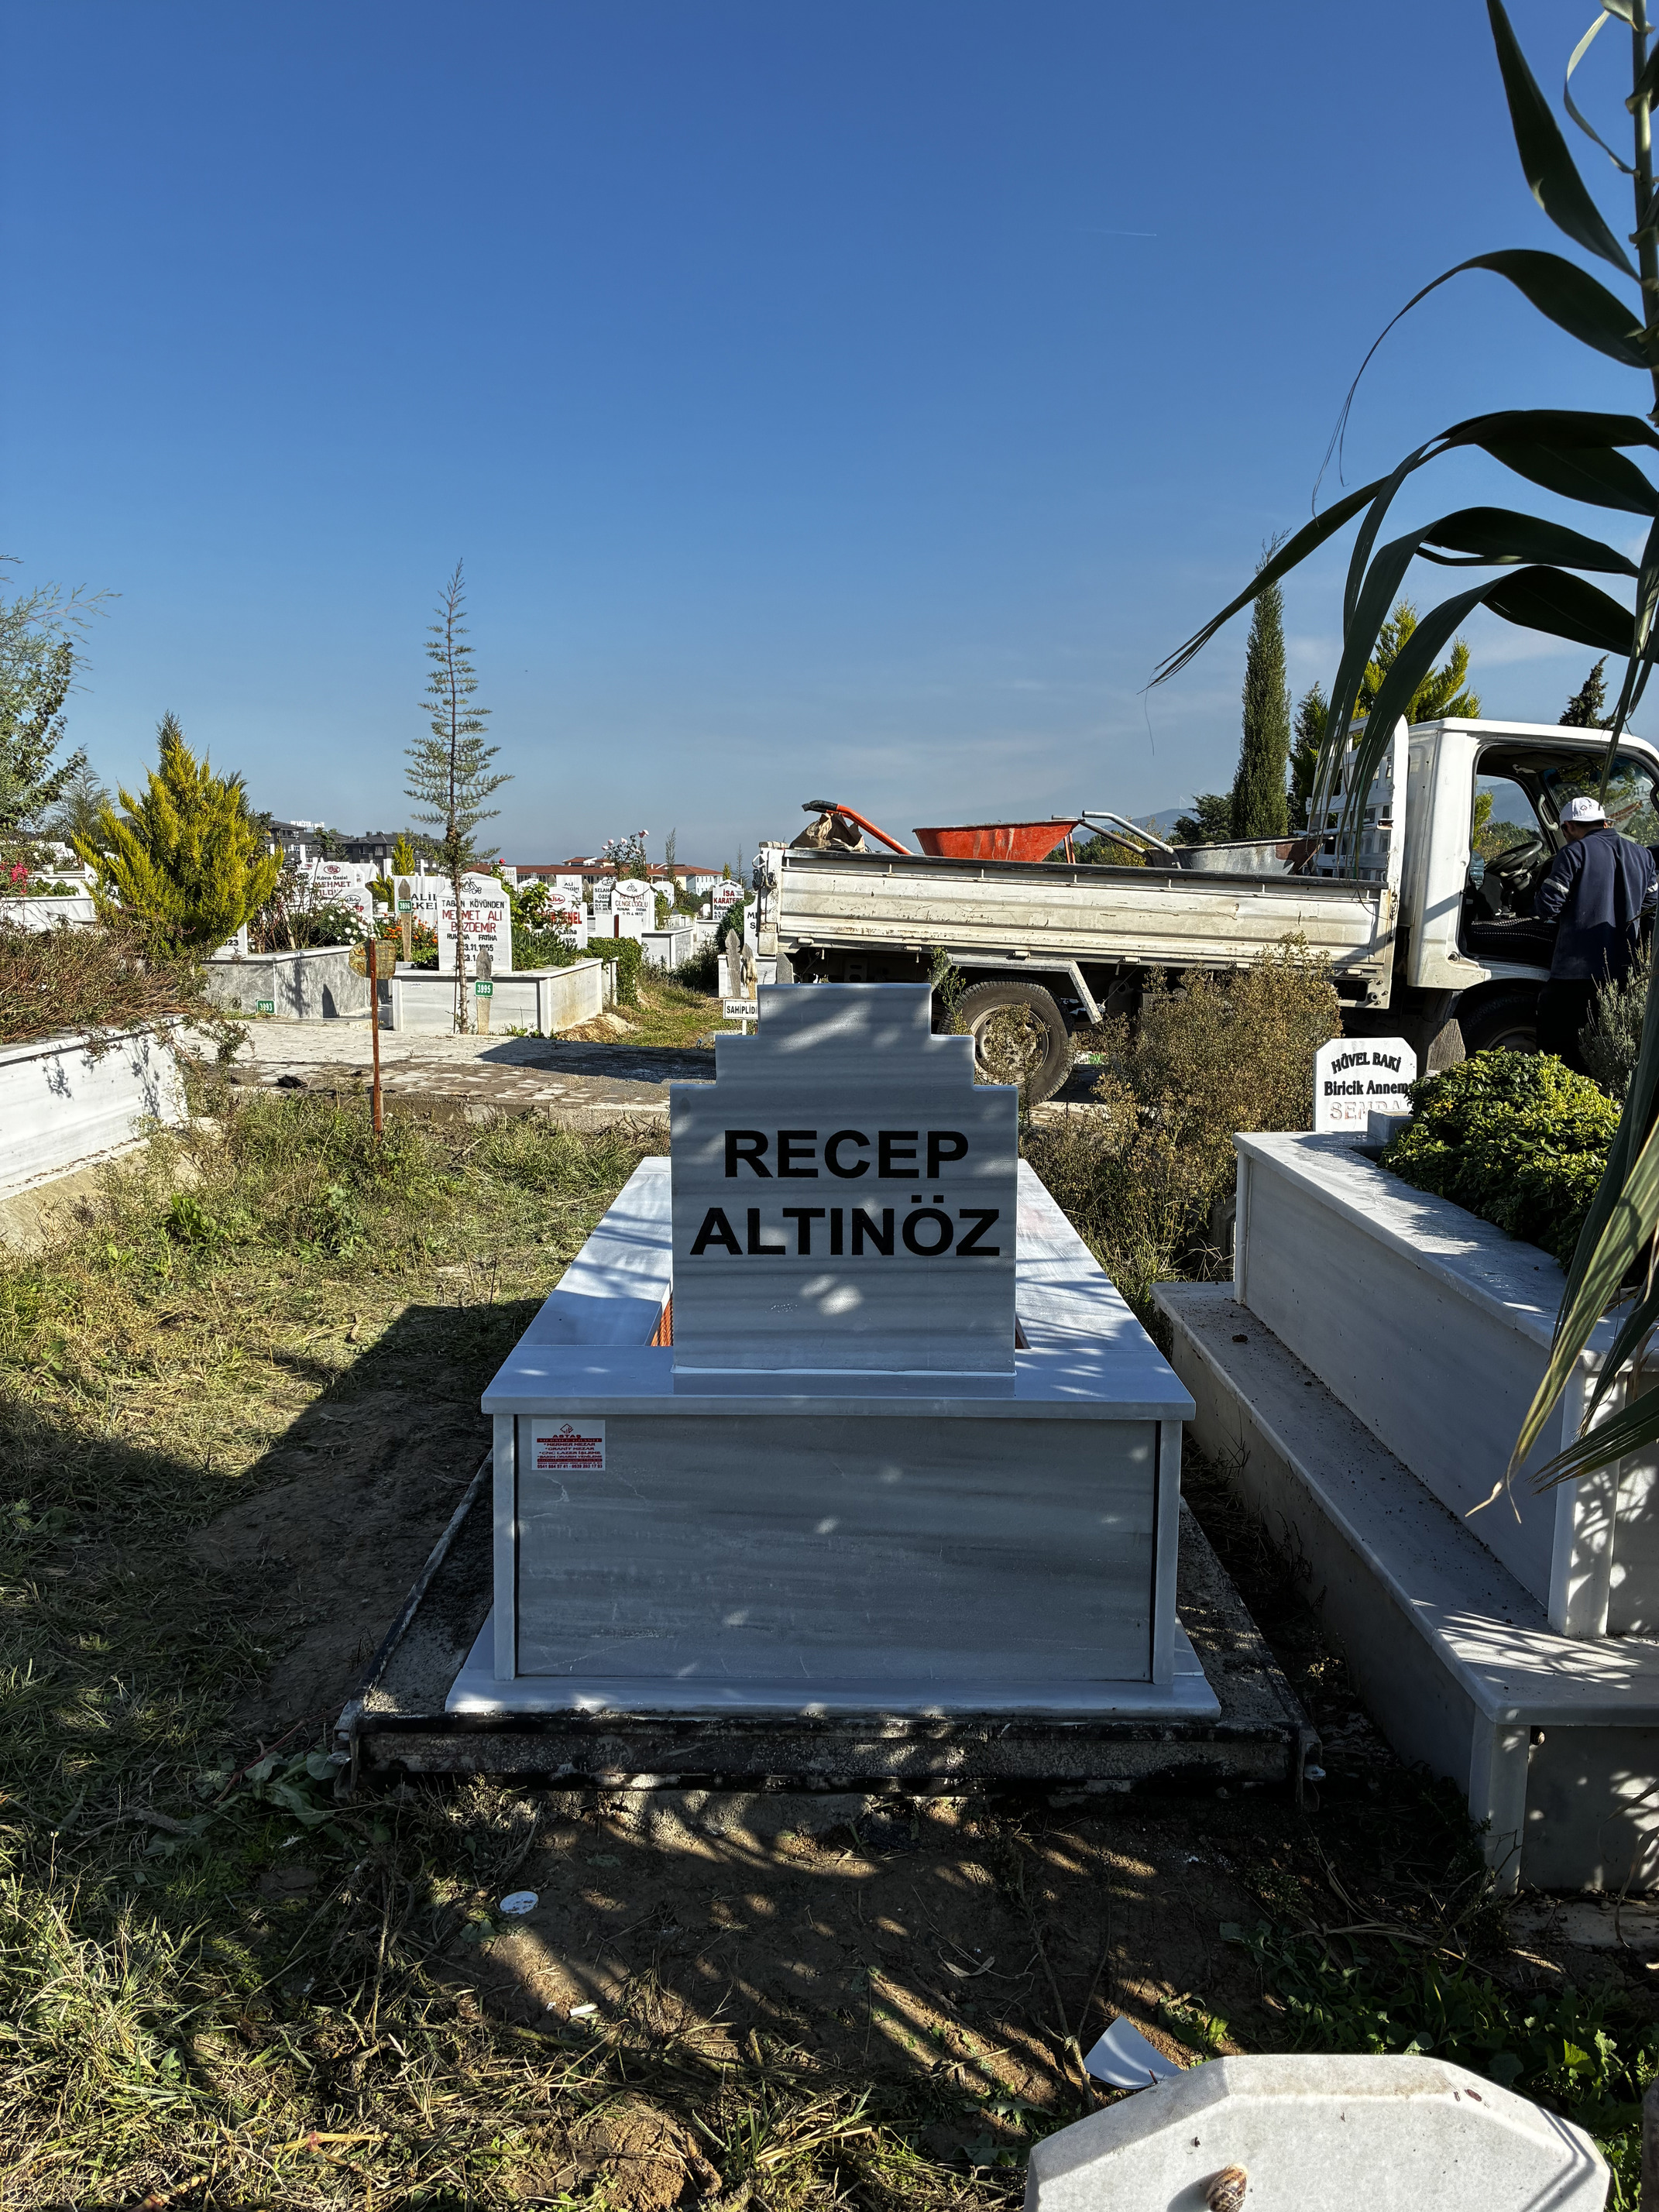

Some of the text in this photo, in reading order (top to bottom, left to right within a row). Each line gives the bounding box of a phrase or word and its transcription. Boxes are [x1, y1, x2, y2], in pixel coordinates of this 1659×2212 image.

[723, 888, 735, 897] İSA
[469, 898, 505, 908] KÖYÜNDEN
[442, 909, 503, 922] MEMET ALİ
[451, 921, 496, 933] BZDEMİR
[476, 984, 491, 994] 3995
[1331, 1052, 1401, 1074] HÜVEL BAKİ
[1324, 1080, 1364, 1096] Biricik
[724, 1129, 969, 1179] RECEP
[689, 1194, 1001, 1256] ALTINÖZ
